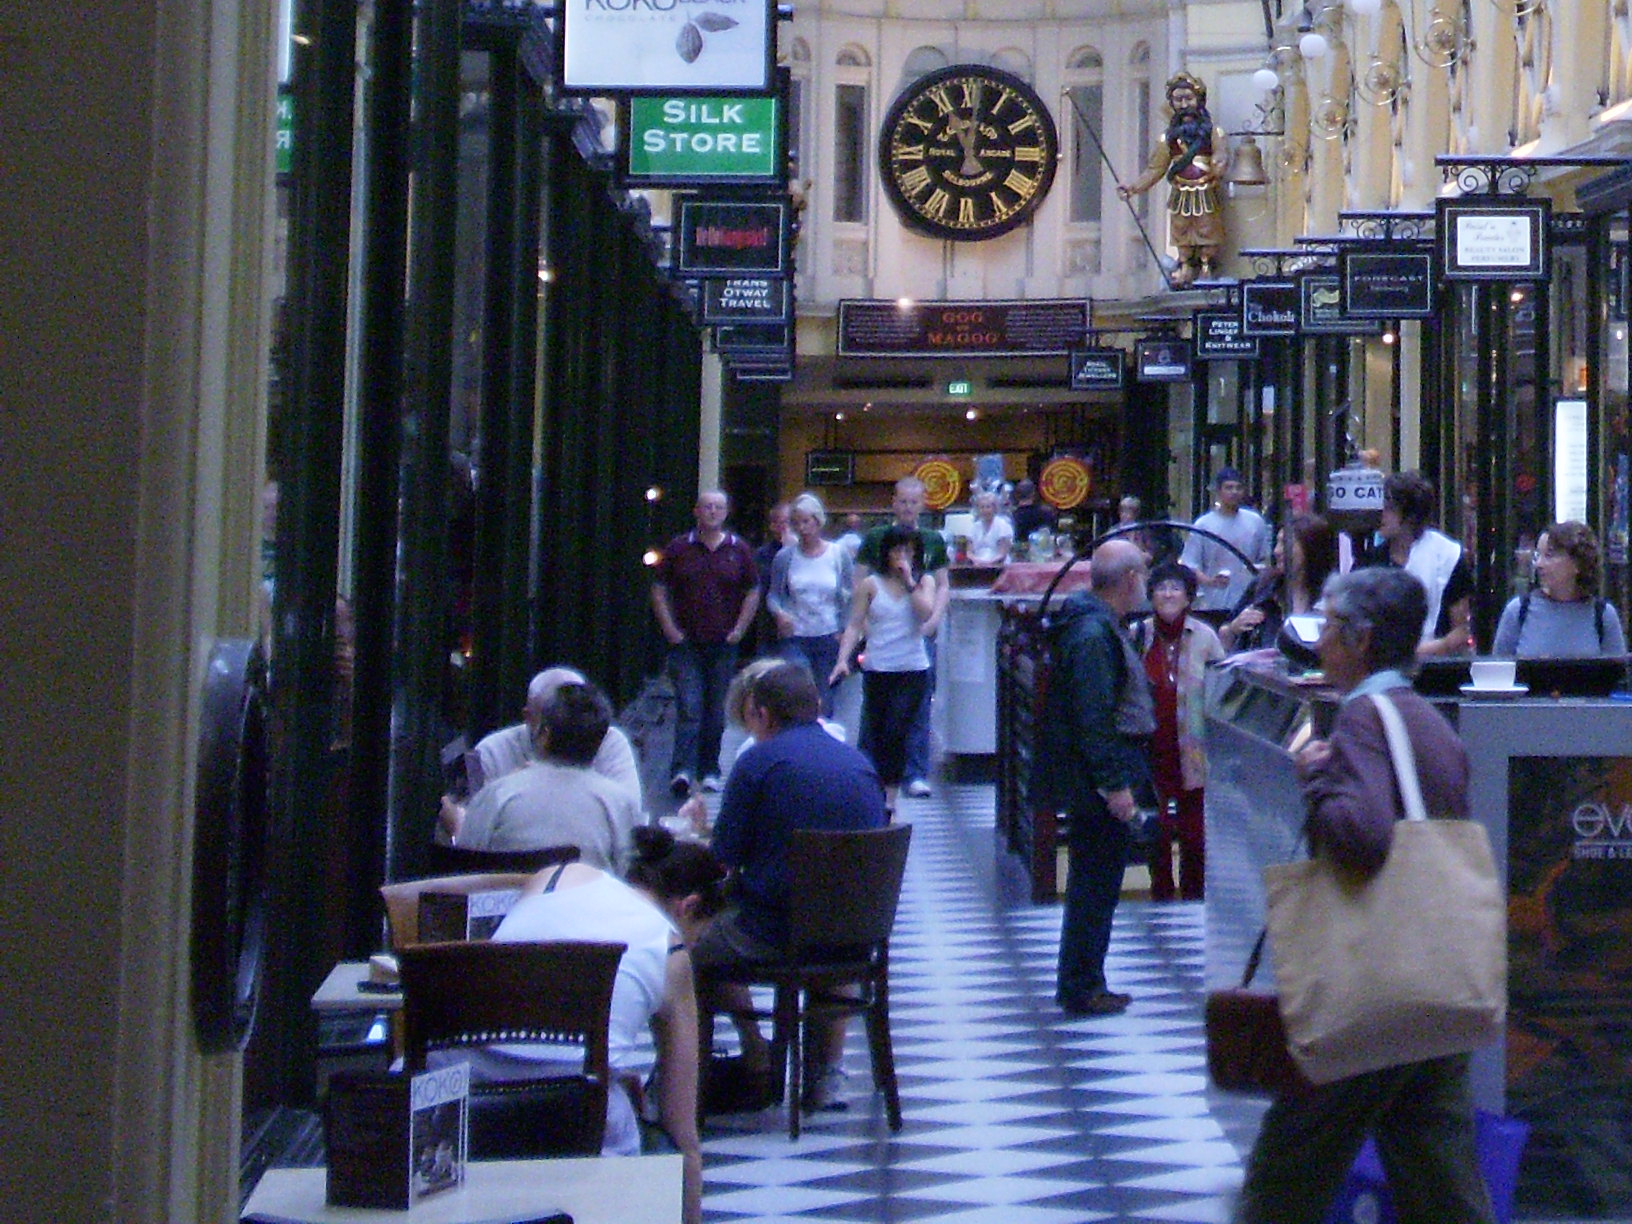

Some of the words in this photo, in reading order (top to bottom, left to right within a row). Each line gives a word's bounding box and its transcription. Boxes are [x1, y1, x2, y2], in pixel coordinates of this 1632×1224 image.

[663, 99, 743, 124] SILK
[643, 129, 760, 153] STORE
[723, 287, 769, 297] OTWAY
[719, 298, 771, 308] TRAVEL
[948, 383, 968, 394] EXIT
